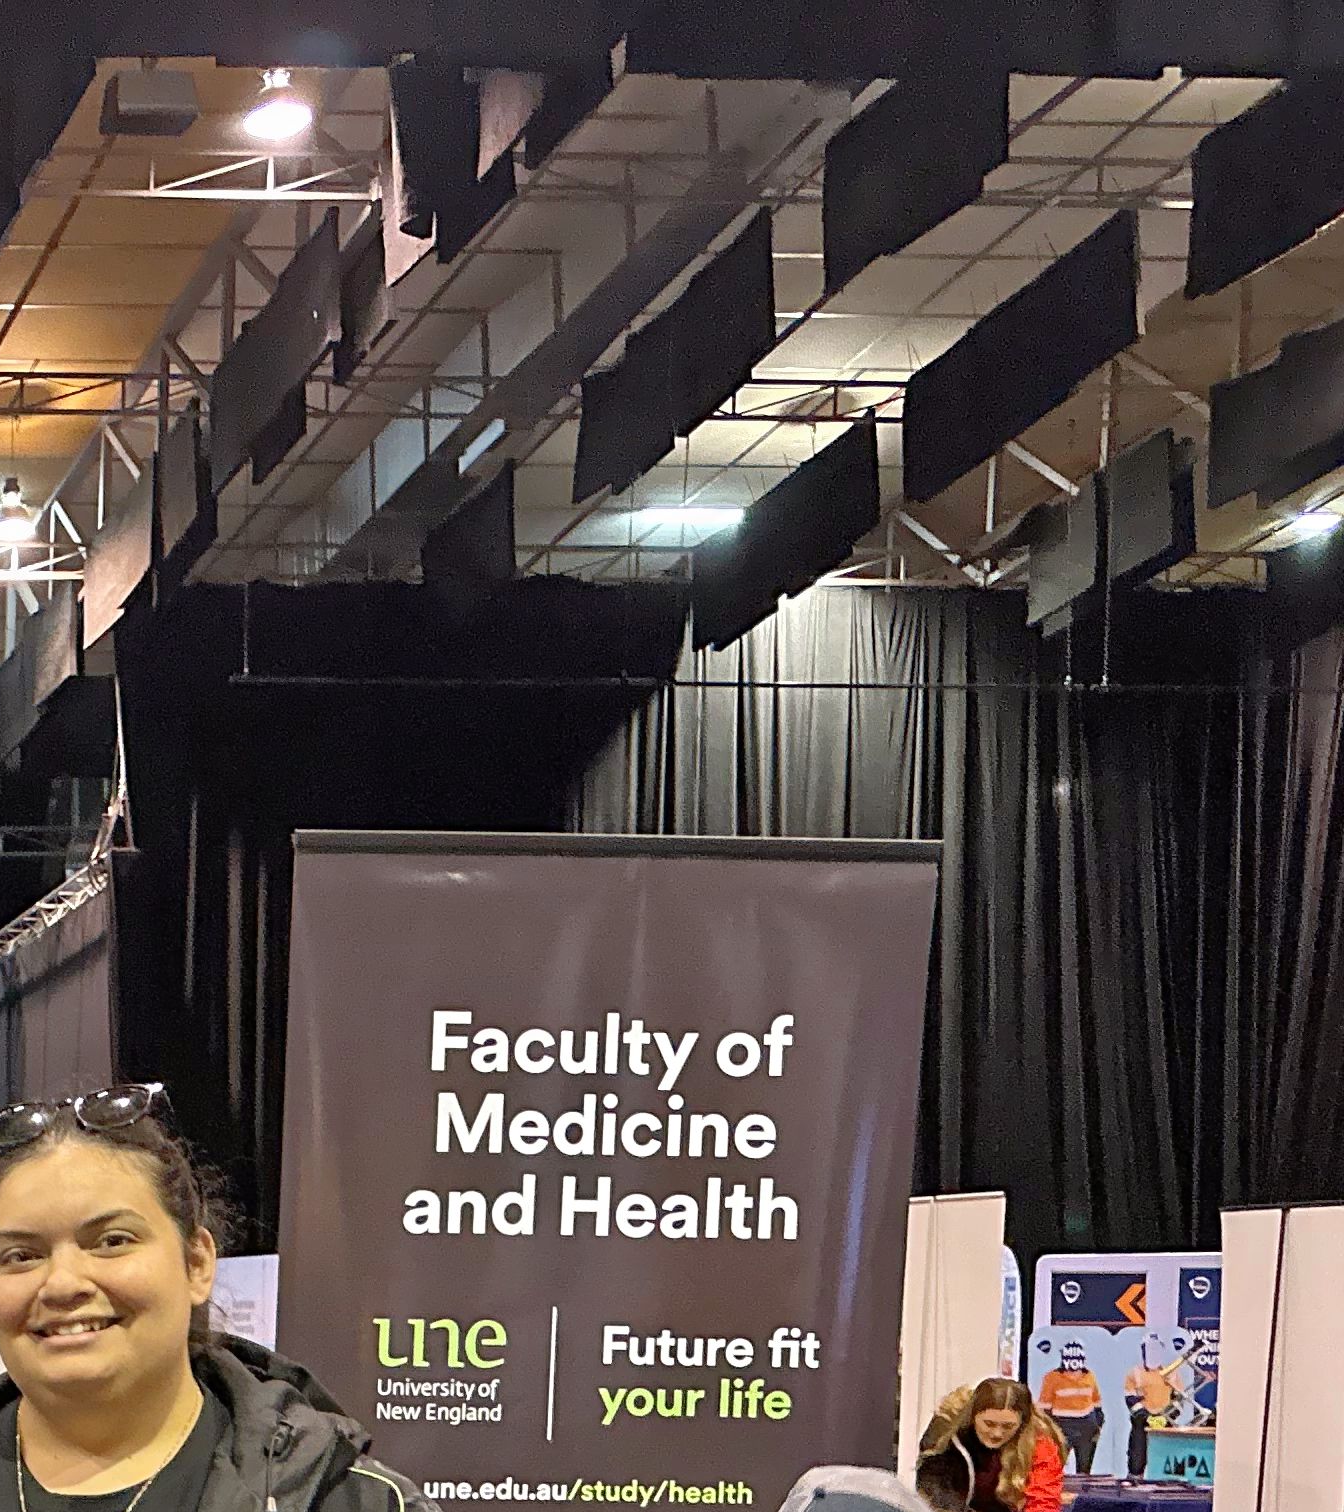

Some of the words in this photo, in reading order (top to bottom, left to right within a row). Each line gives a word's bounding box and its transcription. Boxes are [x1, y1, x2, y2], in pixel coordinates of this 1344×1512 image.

[430, 1010, 699, 1092] Faculty
[715, 1014, 795, 1079] of
[436, 1091, 777, 1160] Medicine
[403, 1173, 535, 1236] and
[560, 1175, 799, 1241] Health
[373, 1317, 507, 1369] une
[602, 1326, 755, 1368] Future
[768, 1328, 820, 1369] fit
[377, 1377, 477, 1404] University
[479, 1377, 500, 1402] of
[377, 1402, 422, 1421] New
[426, 1402, 502, 1426] England
[599, 1385, 705, 1425] your
[719, 1378, 792, 1420] life
[423, 1477, 753, 1508] une.edu.au/study/health
